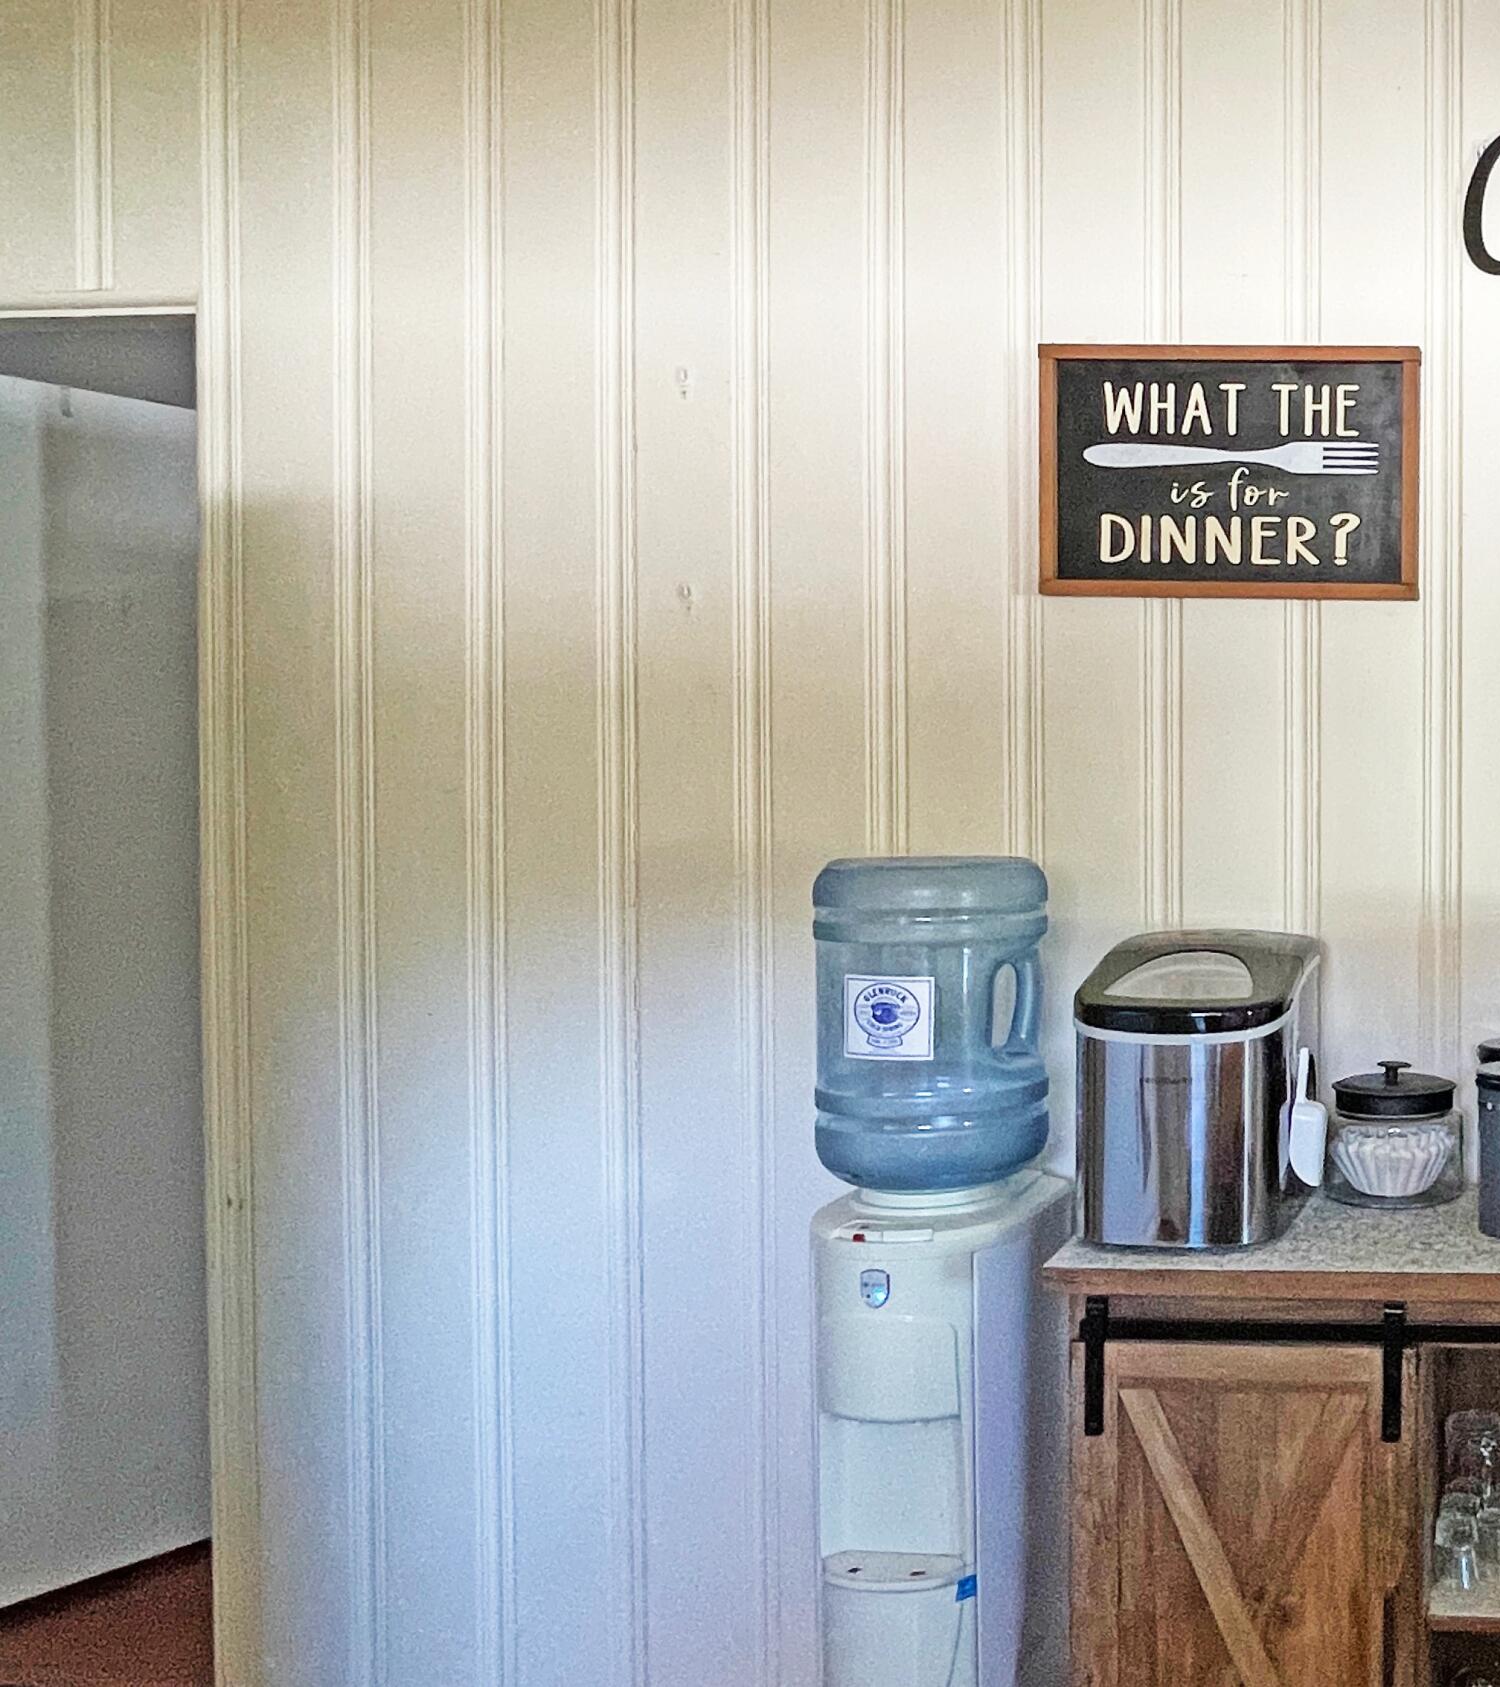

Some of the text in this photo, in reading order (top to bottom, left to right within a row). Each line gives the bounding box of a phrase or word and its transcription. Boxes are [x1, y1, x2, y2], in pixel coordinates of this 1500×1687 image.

[1102, 379, 1361, 438] WHAT THE
[1170, 466, 1290, 512] is for
[1099, 511, 1362, 567] DINNER?
